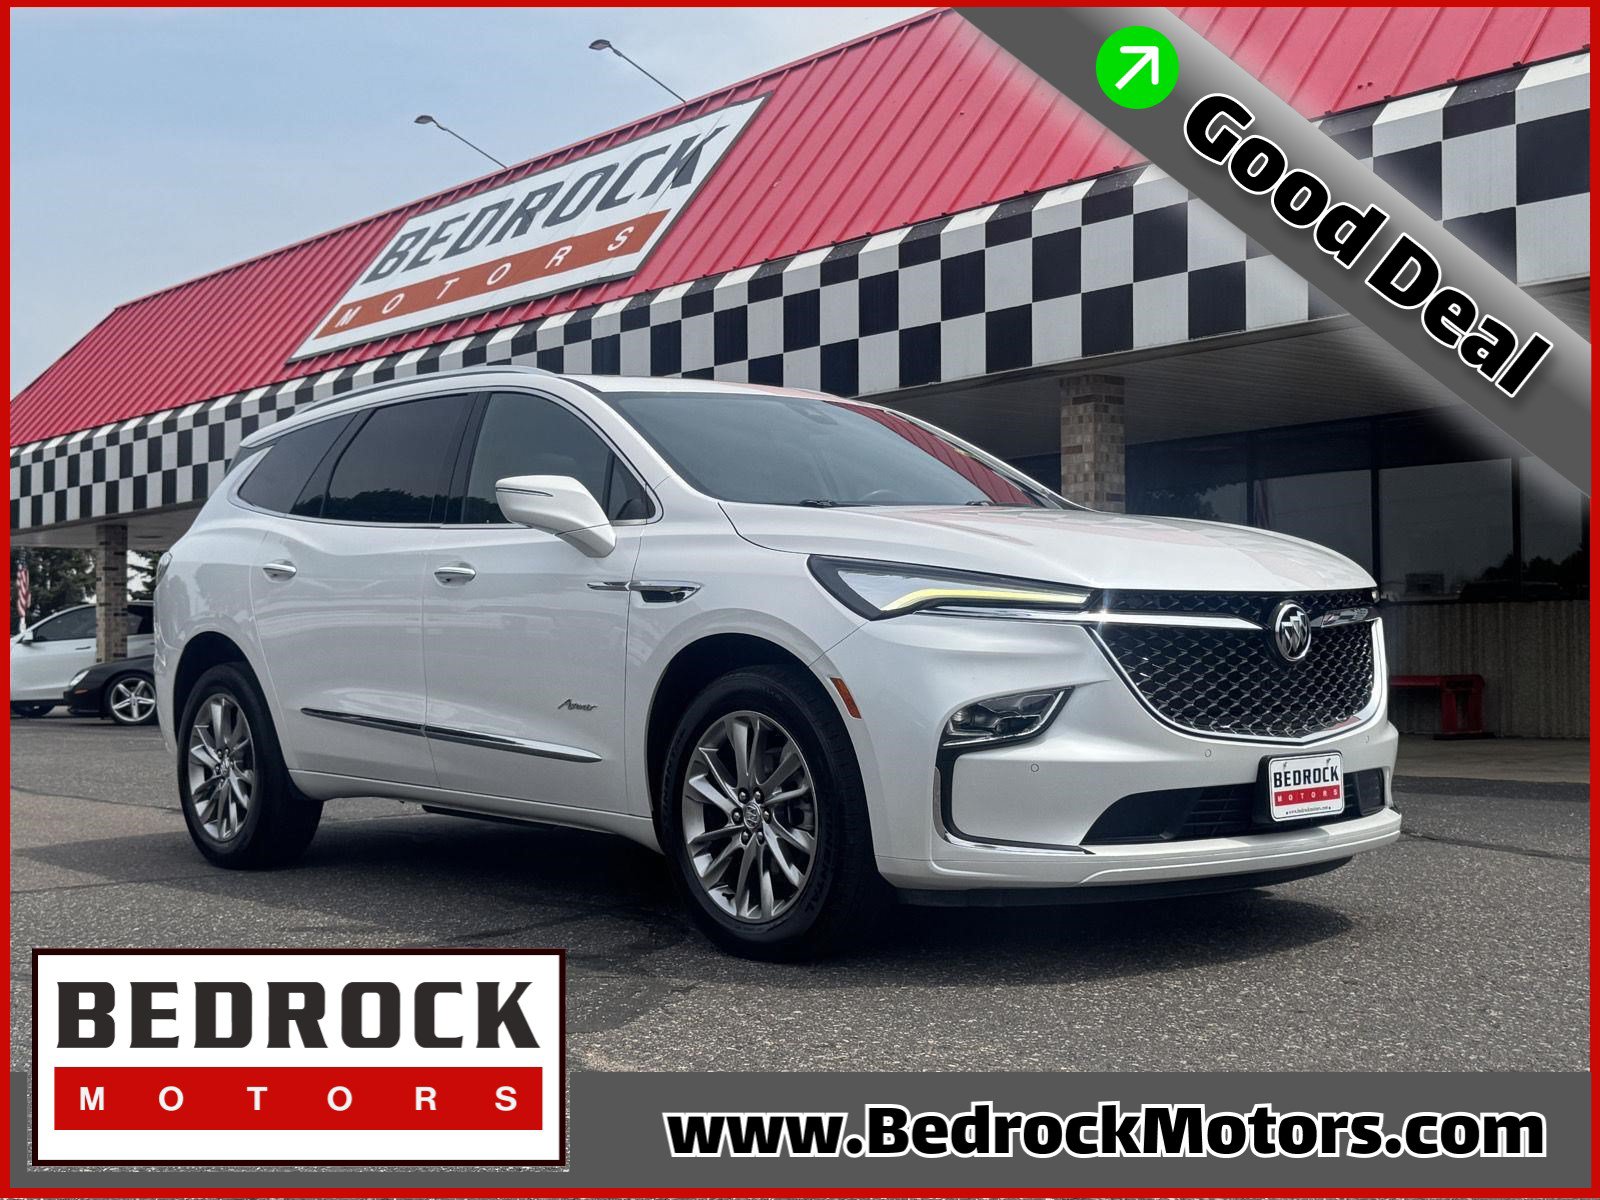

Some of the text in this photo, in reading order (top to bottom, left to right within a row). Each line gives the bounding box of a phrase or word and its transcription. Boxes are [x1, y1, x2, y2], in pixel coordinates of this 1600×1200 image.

[361, 124, 730, 286] BEDROCK
[335, 226, 635, 328] MOTORS
[1273, 765, 1339, 788] BEDROCK
[1277, 788, 1338, 803] MOTORS
